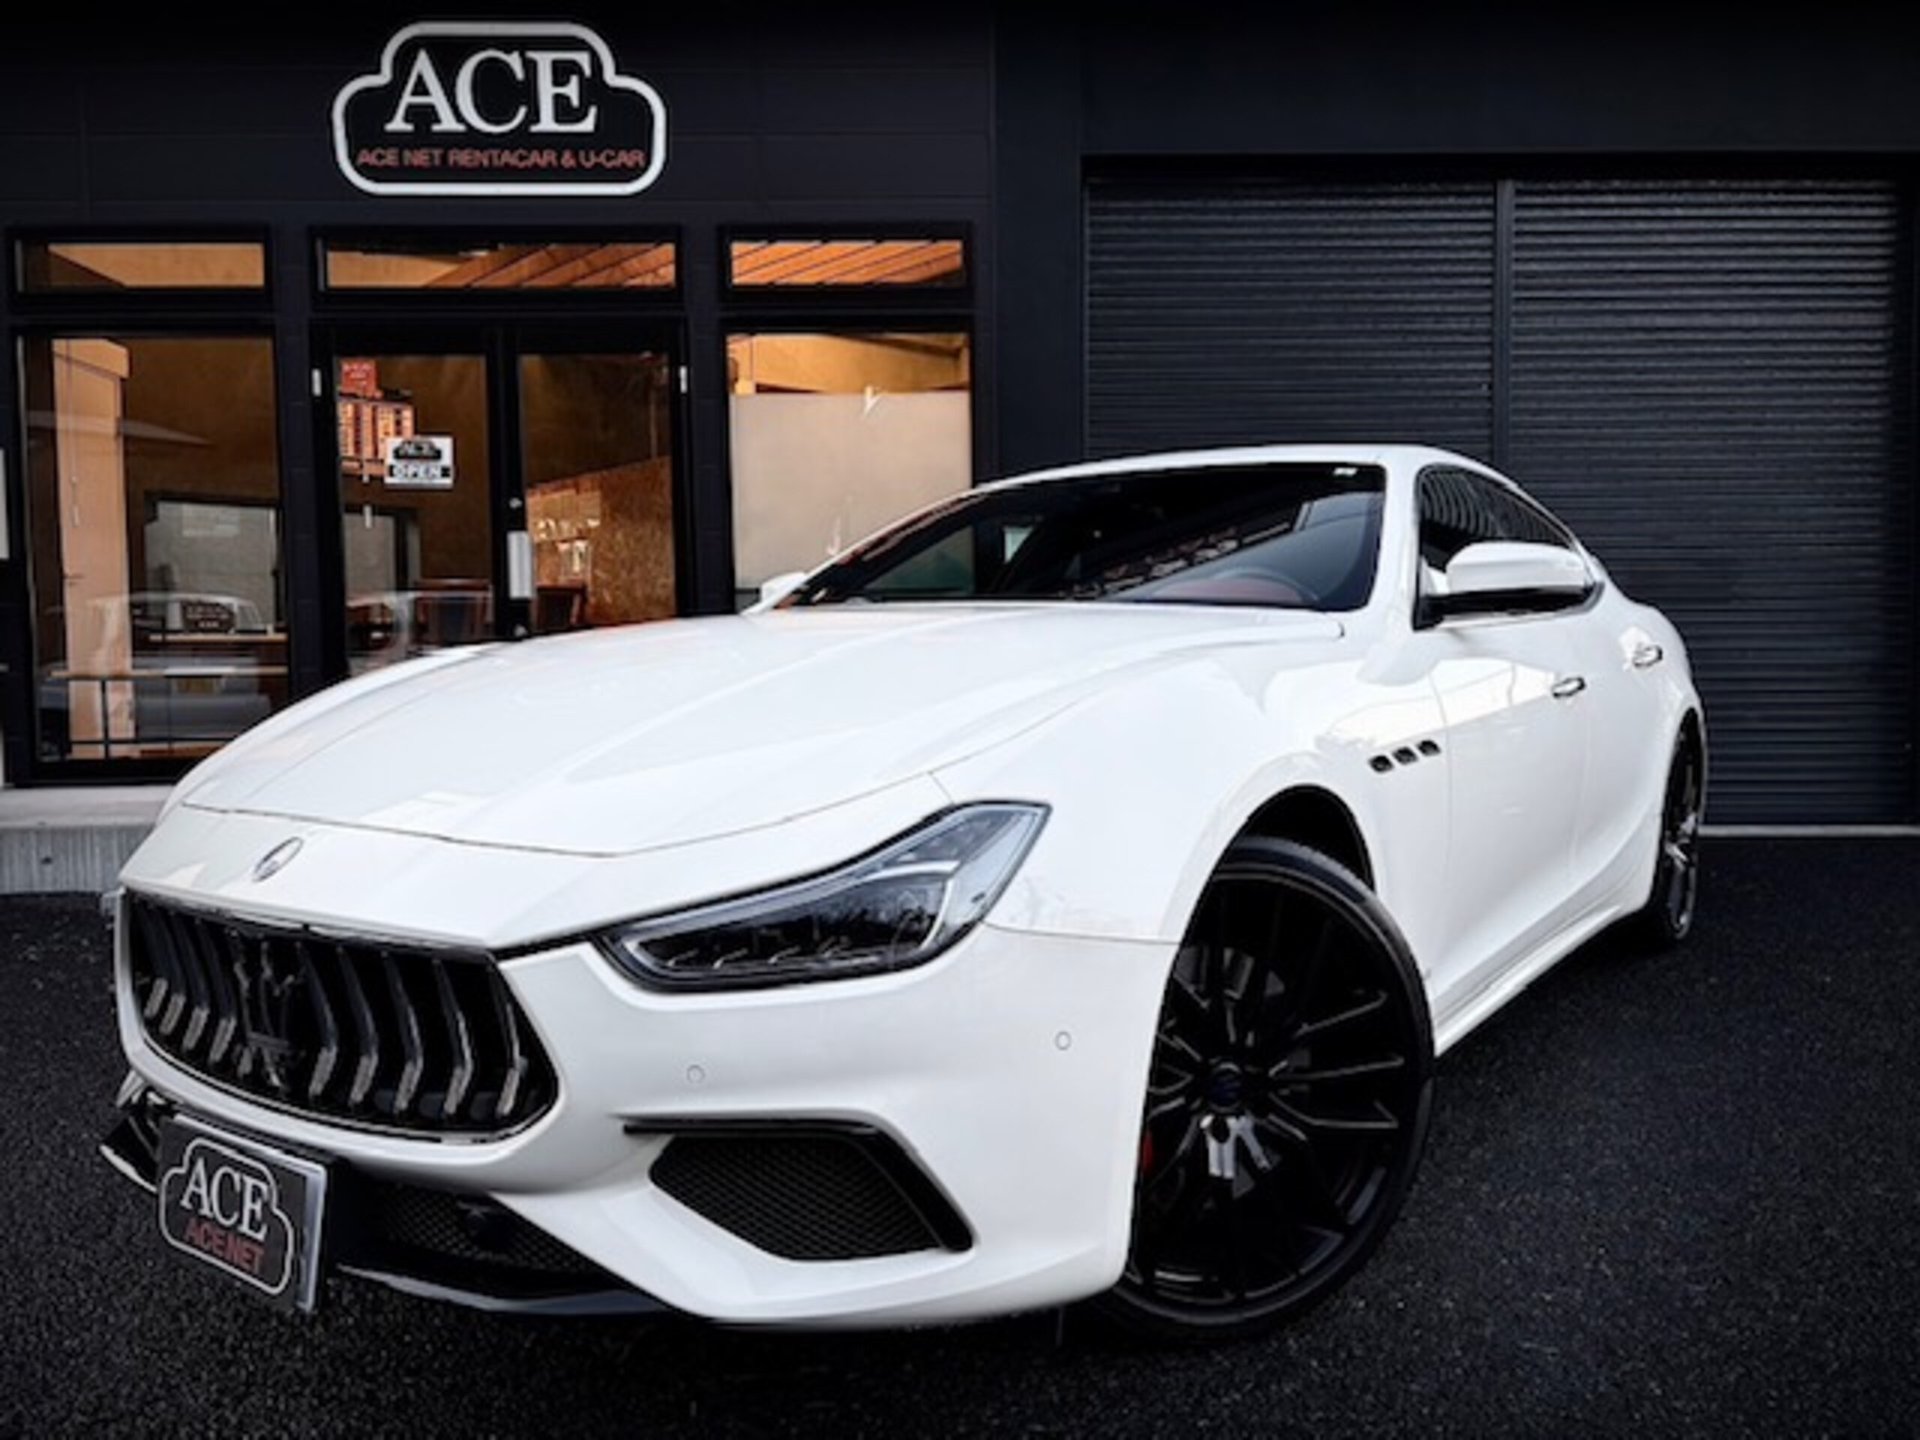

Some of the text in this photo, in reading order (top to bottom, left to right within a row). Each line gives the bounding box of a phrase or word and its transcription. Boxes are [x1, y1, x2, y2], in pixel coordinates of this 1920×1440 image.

[384, 49, 597, 133] ACE
[357, 149, 645, 168] ACE NET RENTACAR & U-CAR
[391, 464, 441, 478] OPEN
[180, 1158, 268, 1241] ACE
